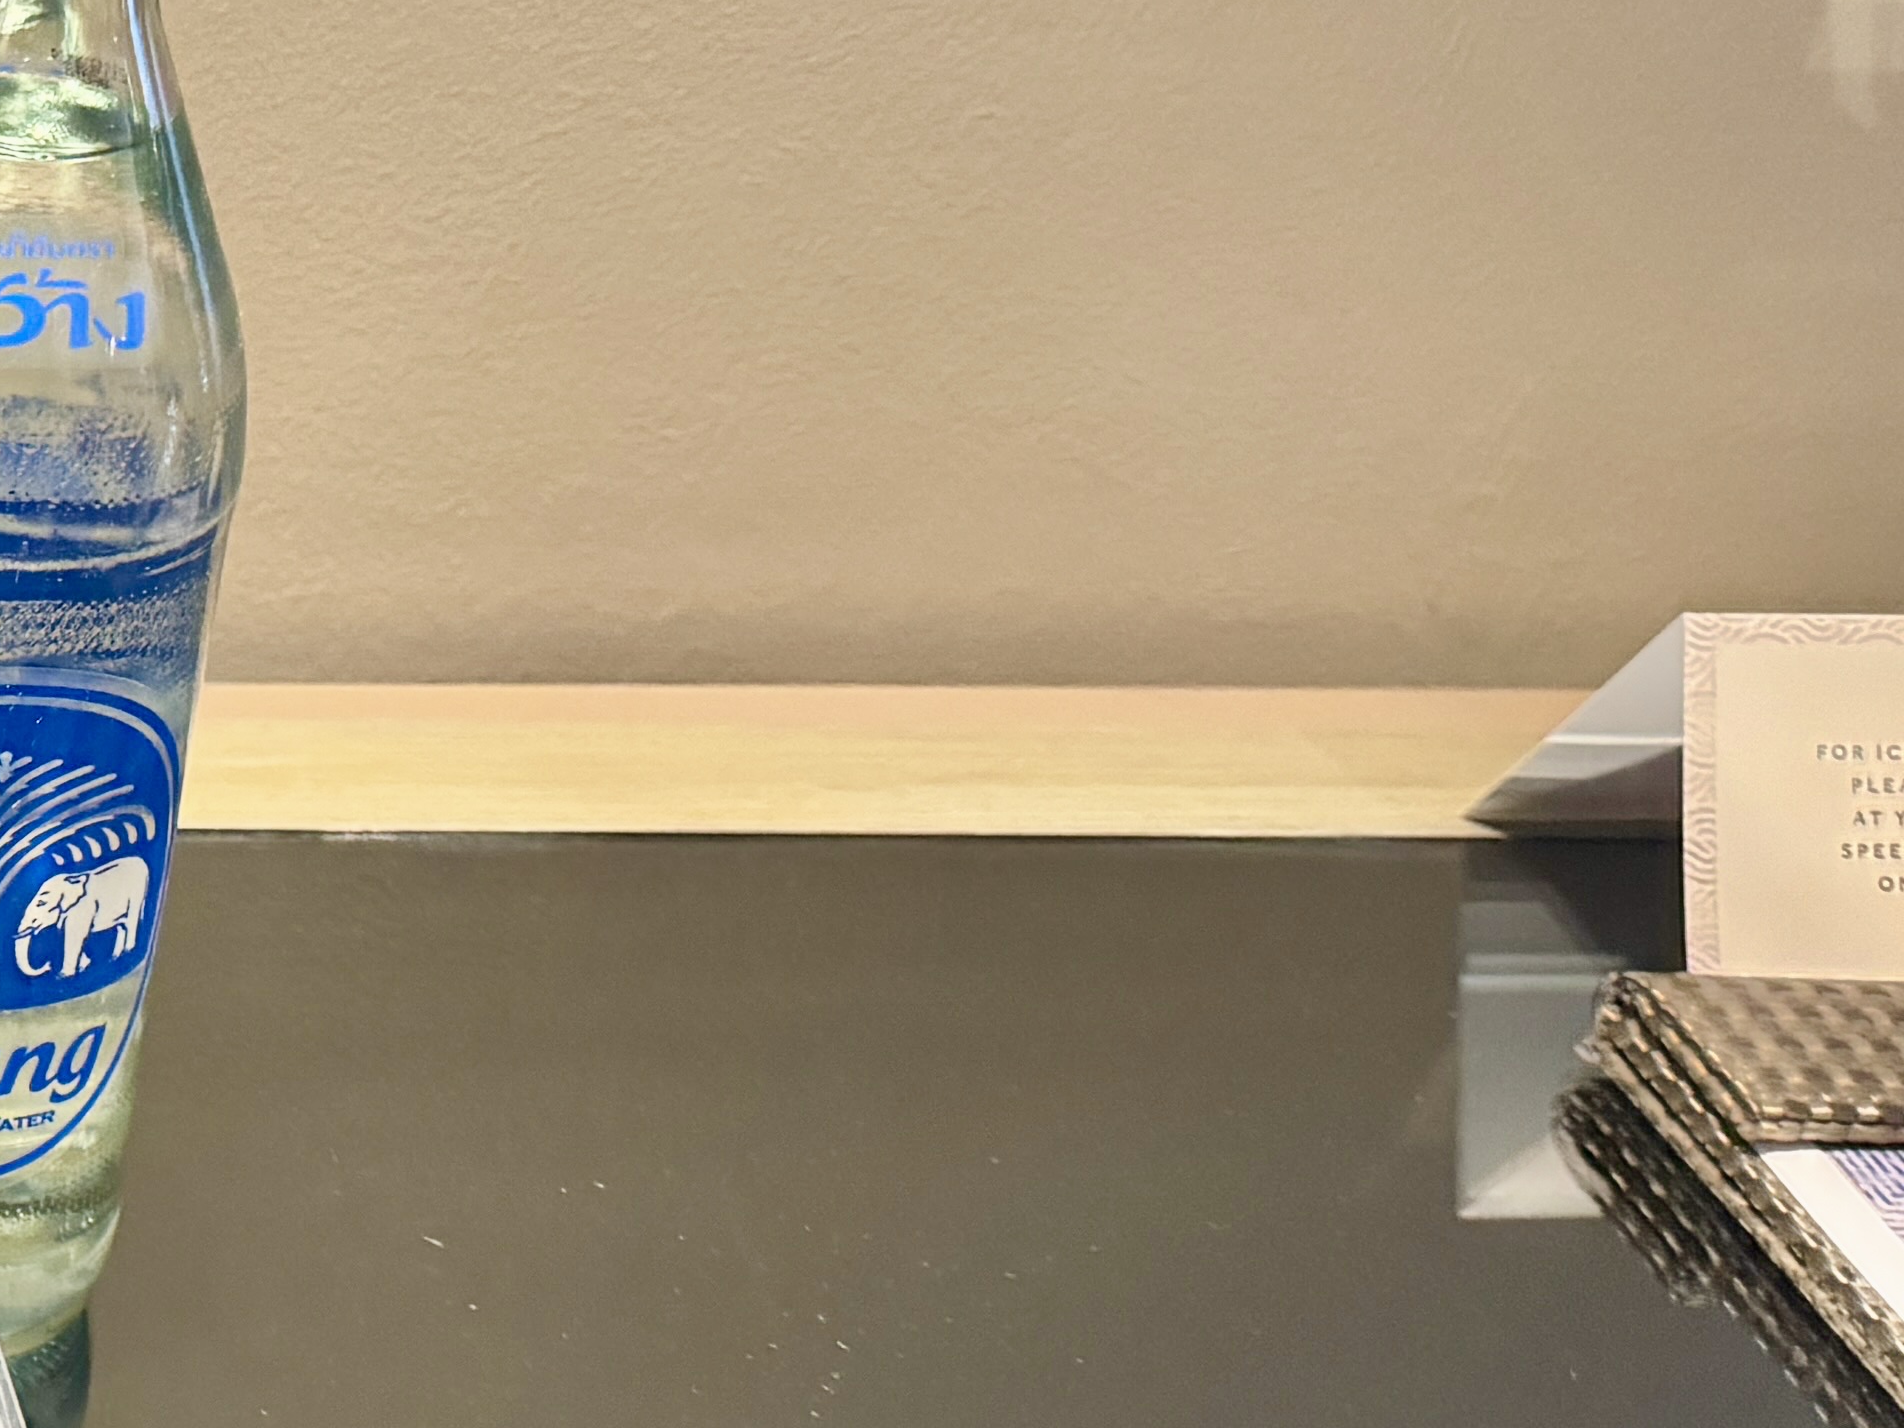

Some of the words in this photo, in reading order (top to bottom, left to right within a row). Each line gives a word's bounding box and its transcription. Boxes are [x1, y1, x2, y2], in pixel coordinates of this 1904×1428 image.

[1816, 744, 1865, 761] FOR
[1853, 810, 1883, 826] AT
[1841, 842, 1902, 860] SPEE
